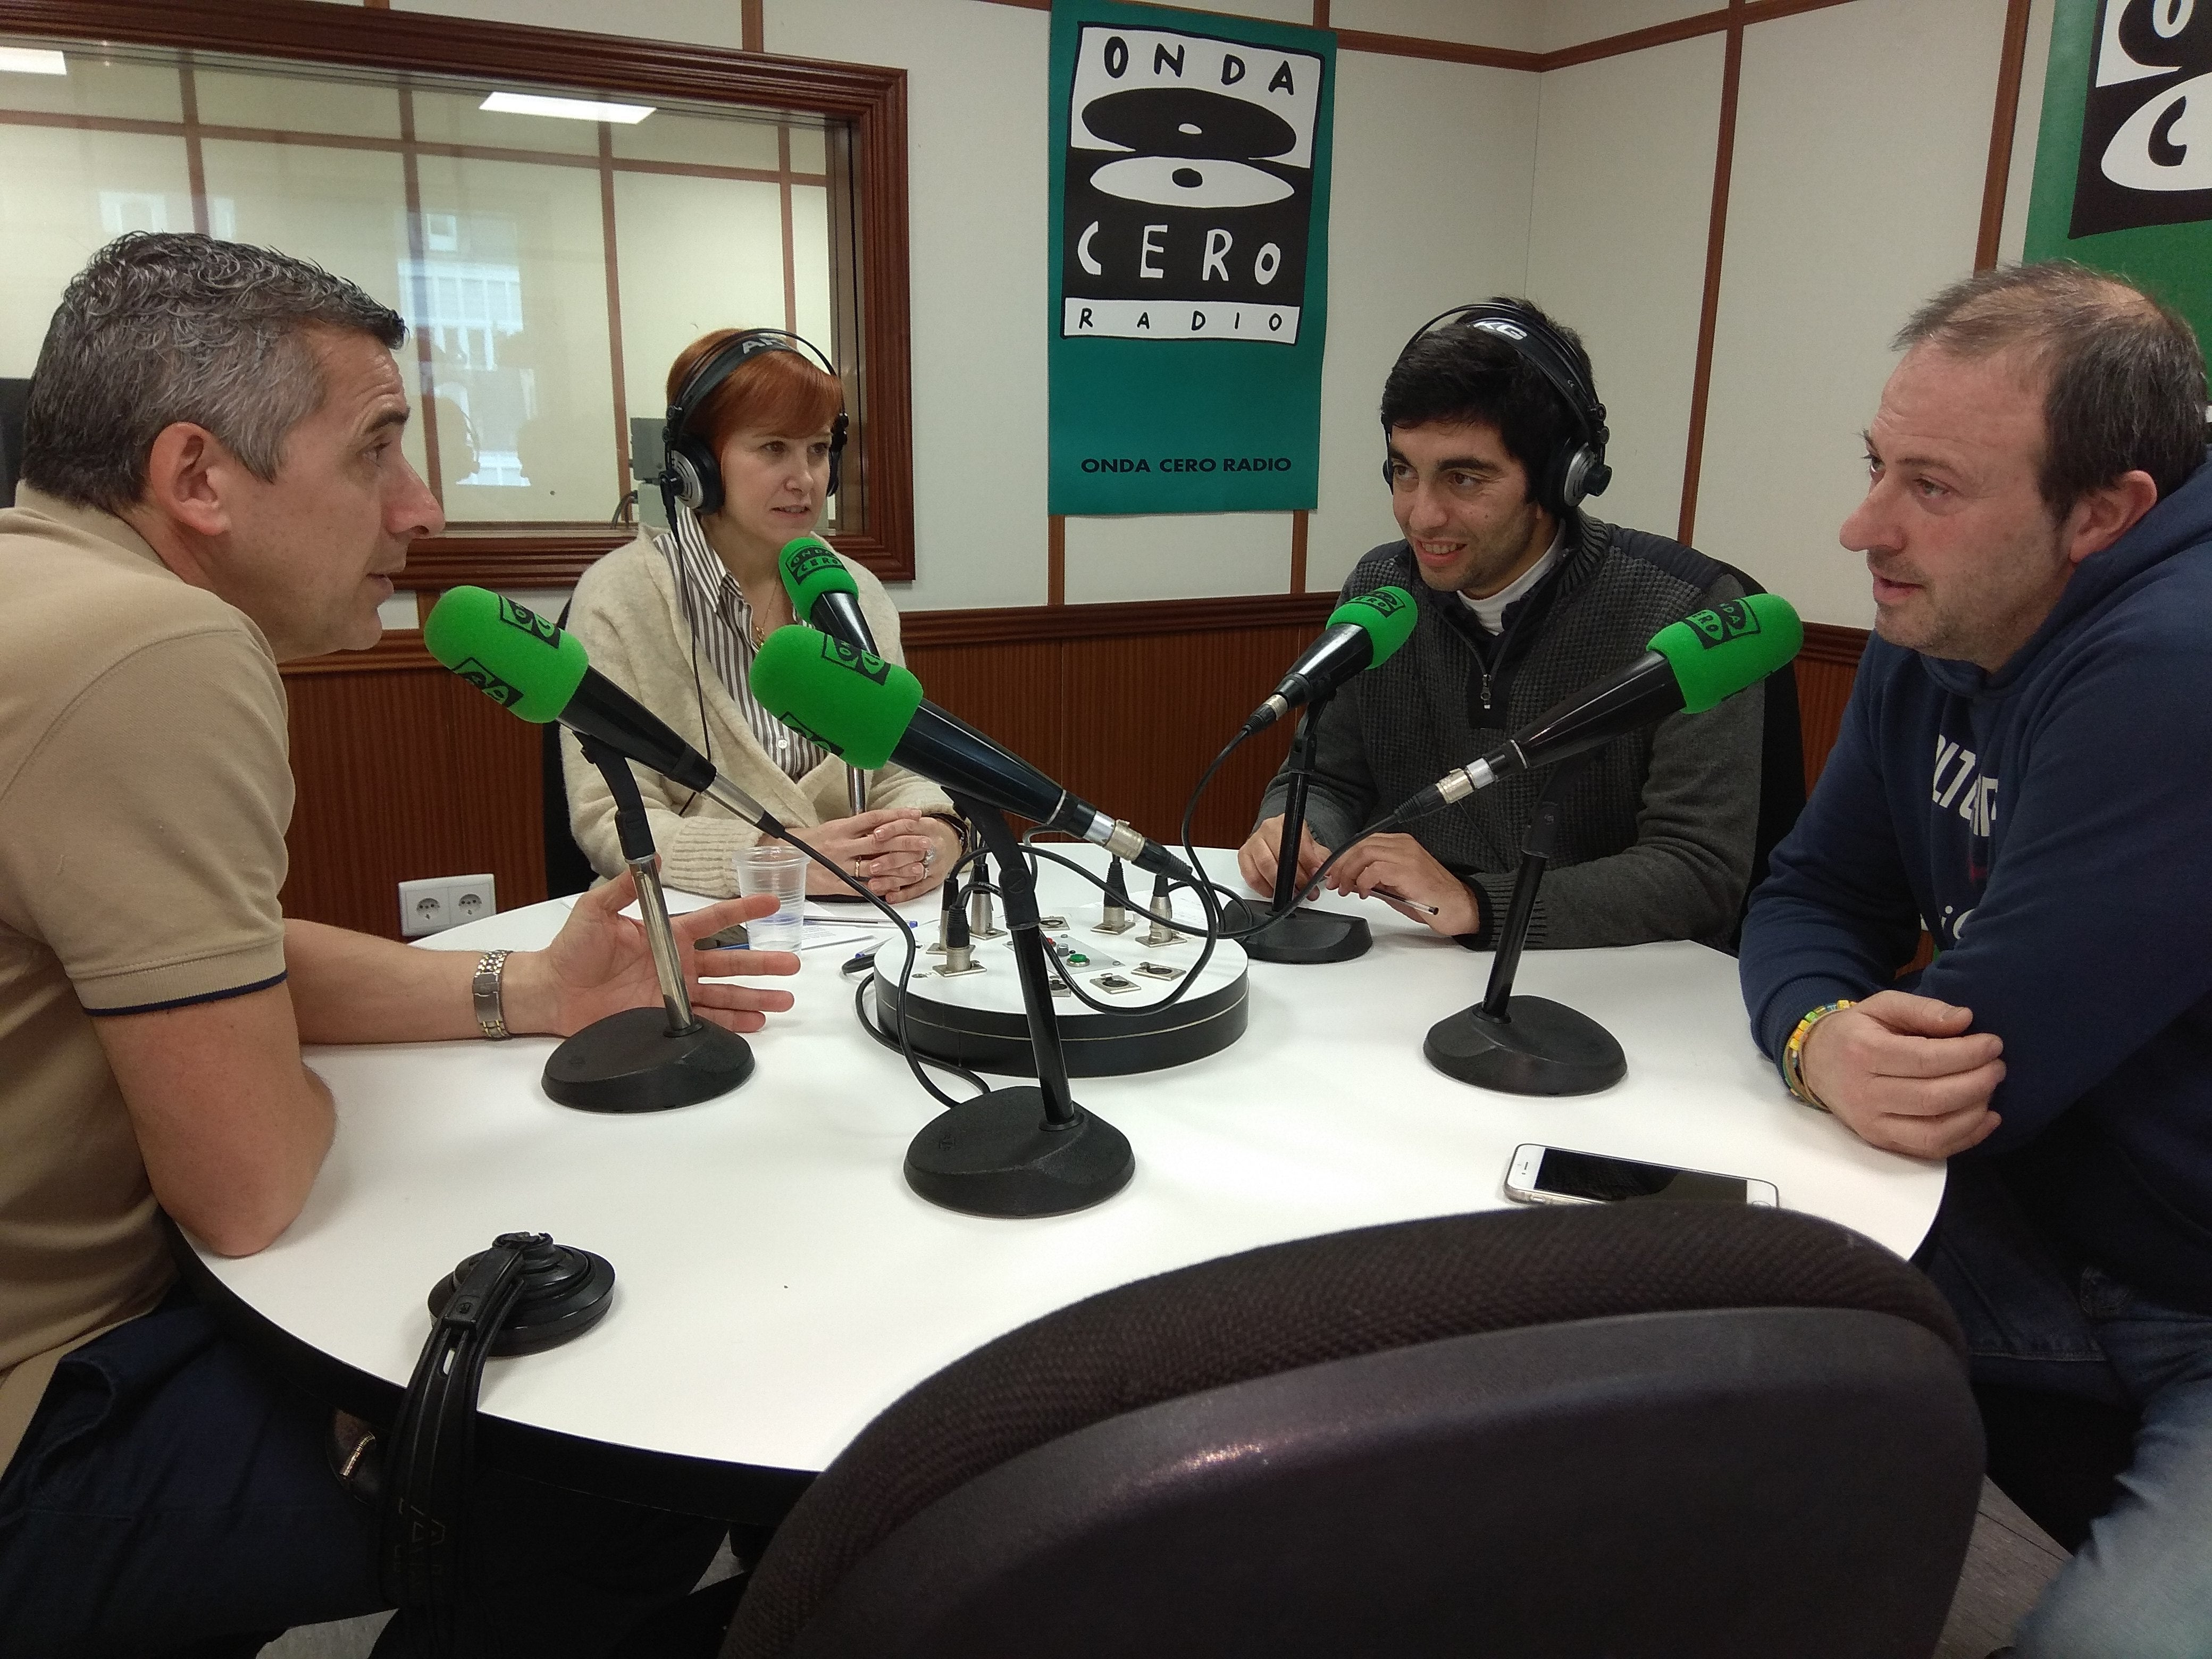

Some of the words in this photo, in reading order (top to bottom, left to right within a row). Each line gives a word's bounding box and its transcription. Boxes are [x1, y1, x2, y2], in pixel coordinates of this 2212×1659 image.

[1104, 36, 1294, 96] ONDA
[1077, 221, 1281, 285] CERO
[1078, 307, 1283, 332] RADIO
[1466, 321, 1528, 340] KG
[1080, 458, 1151, 473] ONDA
[1159, 458, 1217, 473] CERO
[1222, 457, 1292, 473] RADIO
